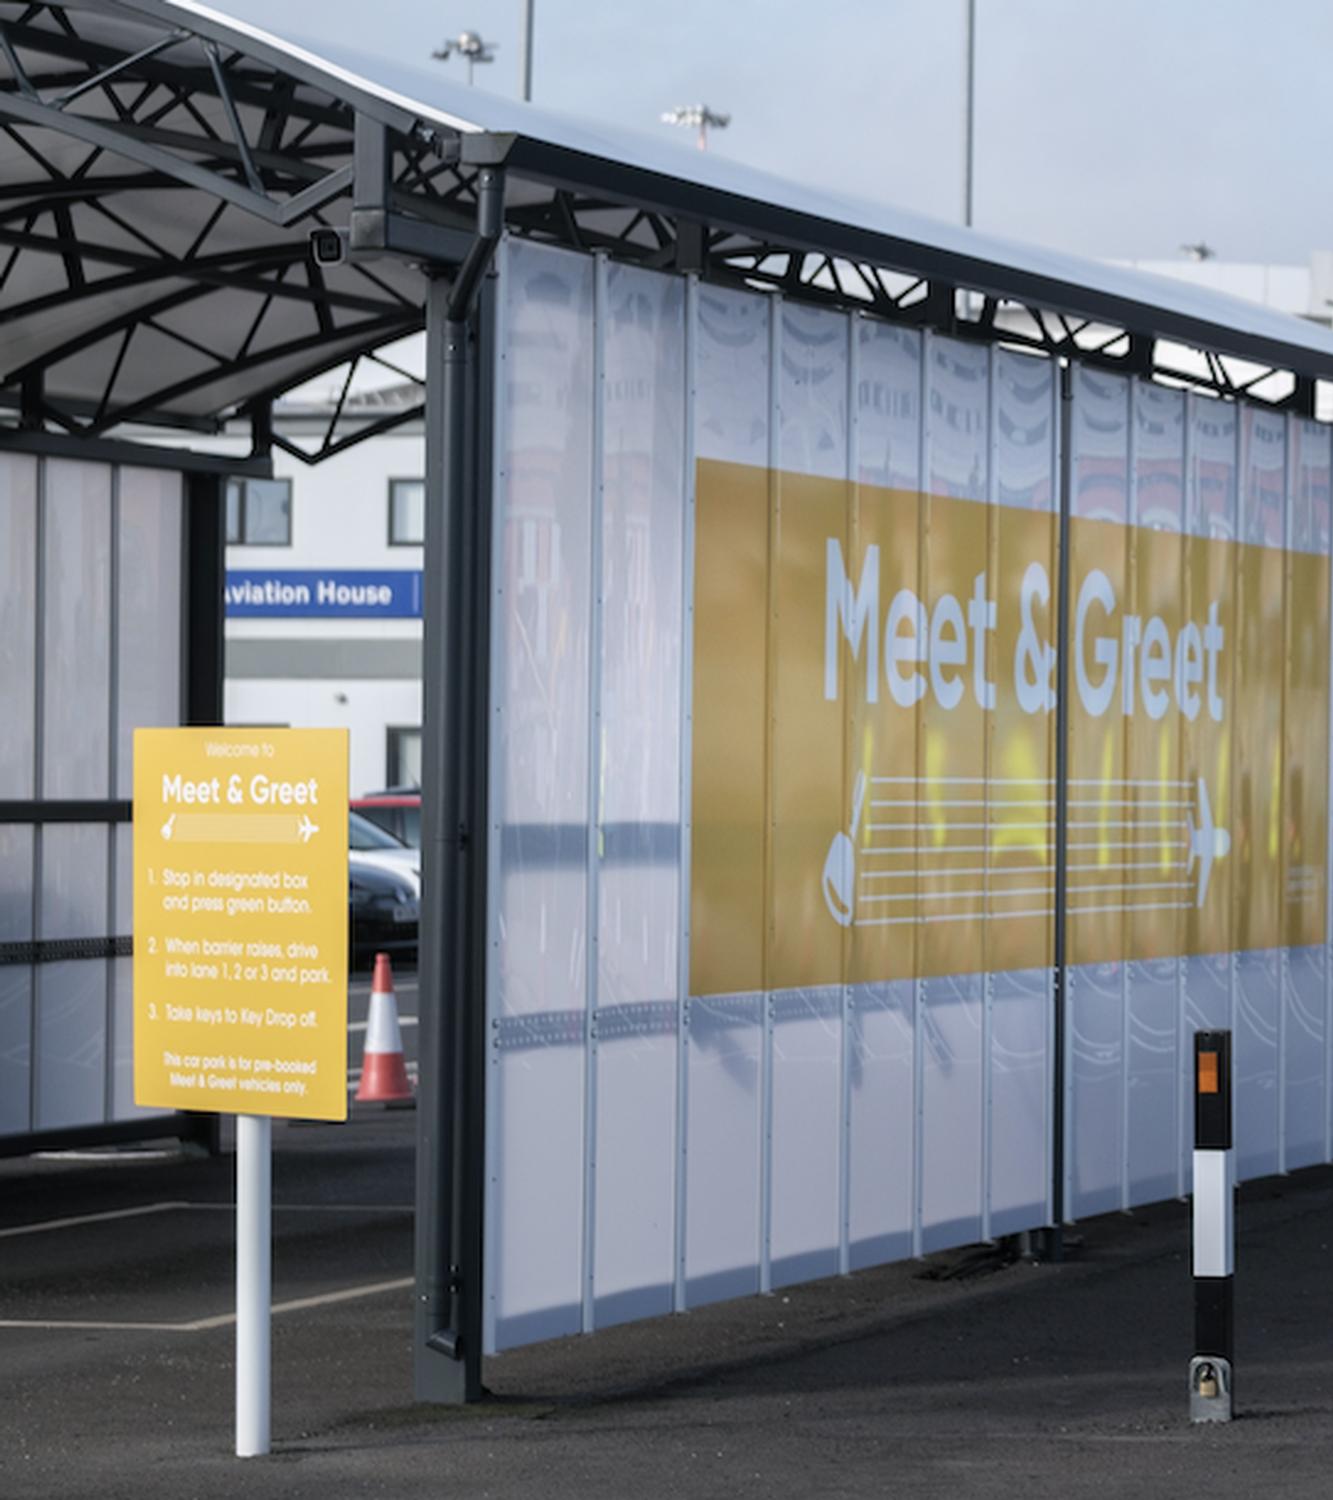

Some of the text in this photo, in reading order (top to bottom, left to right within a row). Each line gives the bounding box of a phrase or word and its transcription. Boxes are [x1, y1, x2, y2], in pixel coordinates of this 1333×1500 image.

[317, 581, 393, 606] House
[824, 537, 1224, 721] Meet & Greet
[205, 742, 274, 757] Welcome to
[162, 774, 318, 804] Meet & Greet
[148, 868, 308, 892] 1. Stop in designated box
[163, 895, 312, 916] and press green button.
[148, 937, 158, 955] 2.
[166, 938, 200, 954] When
[203, 940, 243, 957] barrier
[287, 944, 318, 960] drive
[166, 962, 188, 978] into
[192, 963, 218, 980] lane
[244, 968, 258, 981] or
[261, 965, 268, 981] 3
[271, 966, 298, 982] and
[301, 967, 332, 986] park.
[148, 1003, 159, 1021] 3.
[165, 1004, 193, 1022] Take
[196, 1006, 222, 1026] keys
[225, 1008, 238, 1024] to
[241, 1009, 263, 1028] Key
[266, 1010, 297, 1029] Drop
[163, 1052, 181, 1067] This
[184, 1056, 200, 1068] car
[203, 1056, 225, 1070] park
[239, 1057, 252, 1070] for
[254, 1058, 317, 1074] pre-booked
[170, 1073, 196, 1087] Meet
[198, 1074, 205, 1089] &
[208, 1074, 237, 1090] Greet
[240, 1077, 282, 1092] vehicles
